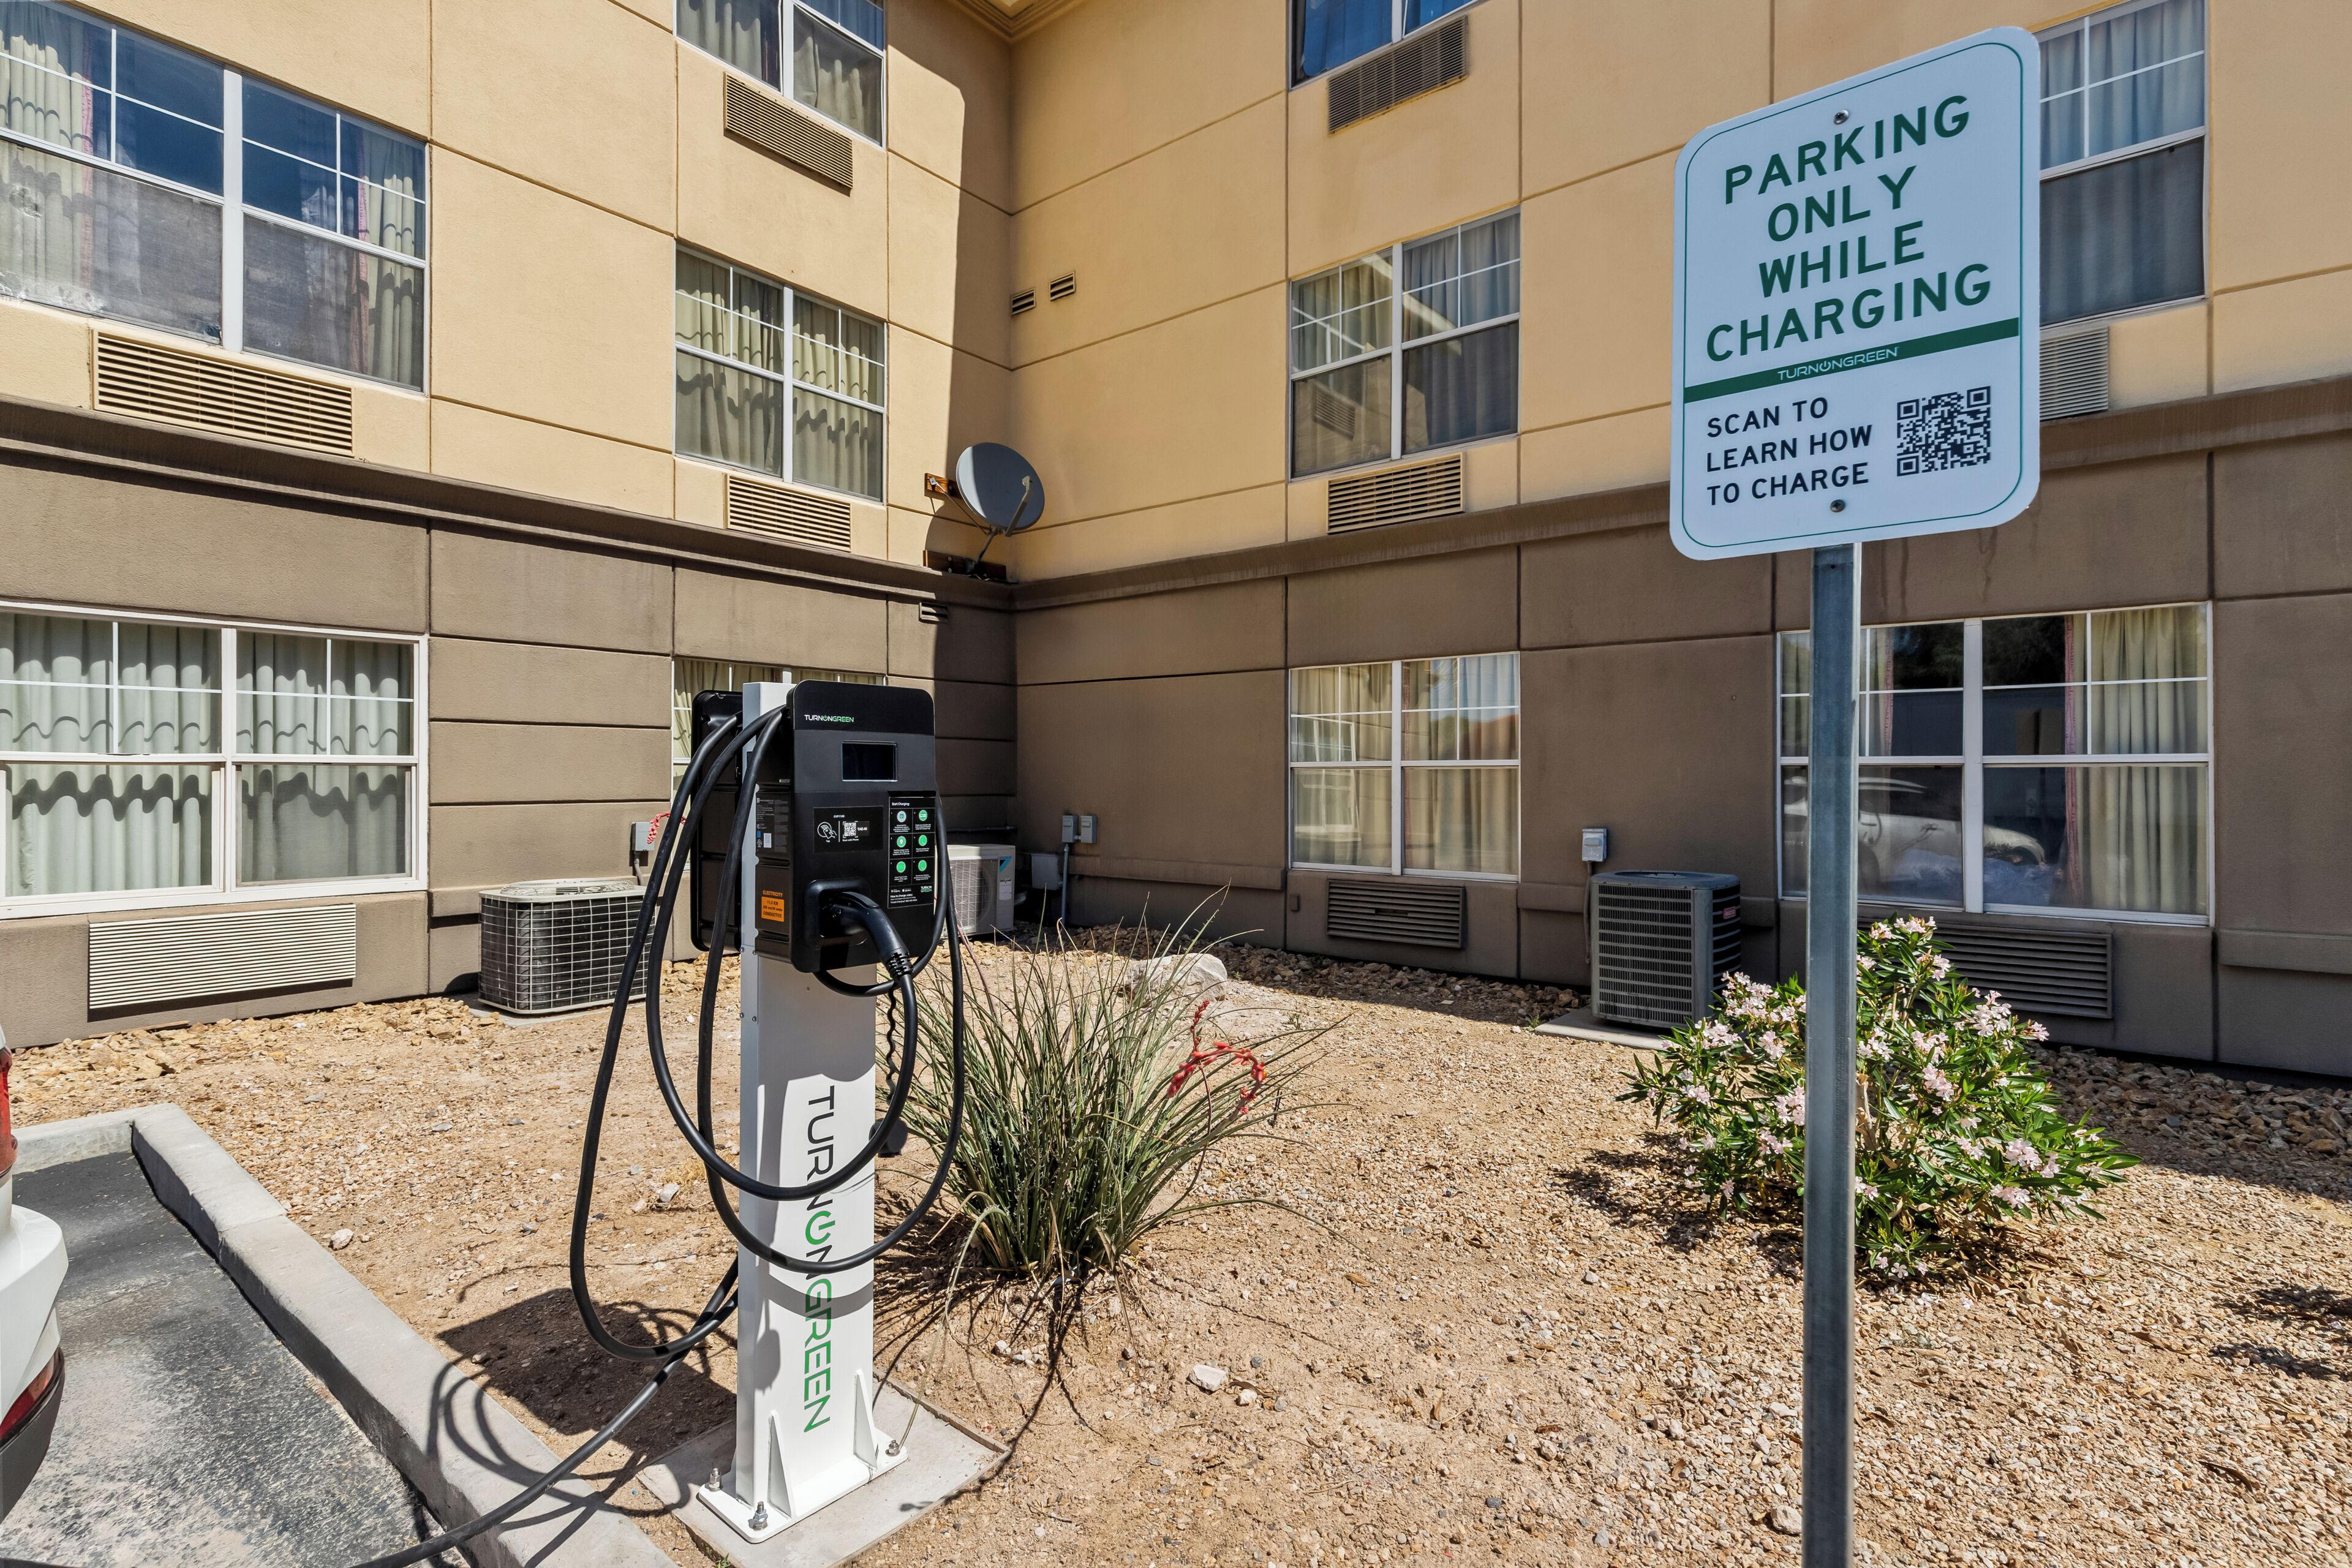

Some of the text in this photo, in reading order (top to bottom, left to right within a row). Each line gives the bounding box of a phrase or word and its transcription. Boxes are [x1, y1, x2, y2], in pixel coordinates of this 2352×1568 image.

[1725, 95, 1969, 205] PARKING
[1768, 165, 1917, 242] ONLY
[1758, 220, 1924, 298] WHILE
[1706, 263, 1991, 362] CHARGING
[1777, 347, 1898, 380] TURNONGREEN
[1707, 397, 1828, 438] SCAN TO
[1706, 424, 1872, 472] LEARN HOW
[1706, 462, 1869, 506] TO CHARGE
[804, 714, 854, 723] TURNONGREEN
